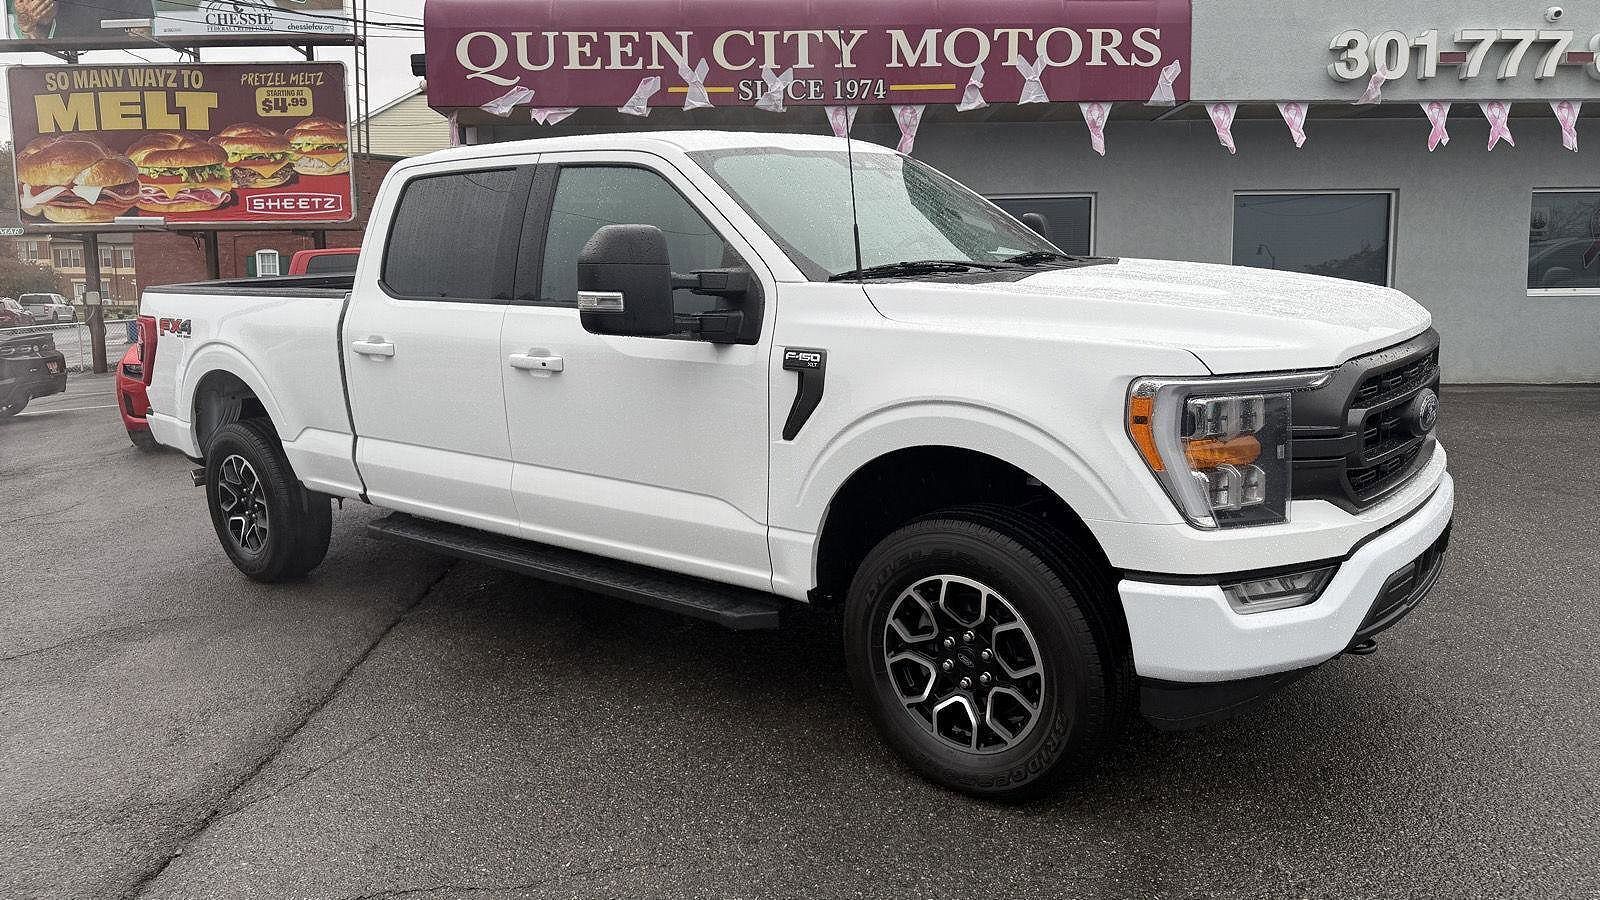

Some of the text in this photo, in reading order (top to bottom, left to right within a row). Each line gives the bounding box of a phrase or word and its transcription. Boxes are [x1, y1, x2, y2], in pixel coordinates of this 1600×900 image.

[205, 13, 274, 25] CHESSIE
[455, 27, 1162, 86] QUEEN CITY MOTORS
[45, 68, 204, 91] SO MANY WAYZ TO
[240, 71, 325, 88] PRETZEL MELTZ
[266, 89, 304, 98] STARTING AT
[738, 79, 887, 101] SICE 1974
[34, 91, 218, 134] MELT
[262, 97, 308, 114] $4.99
[252, 196, 337, 211] SHEETZ
[160, 317, 192, 336] FX4
[785, 351, 821, 362] F-150
